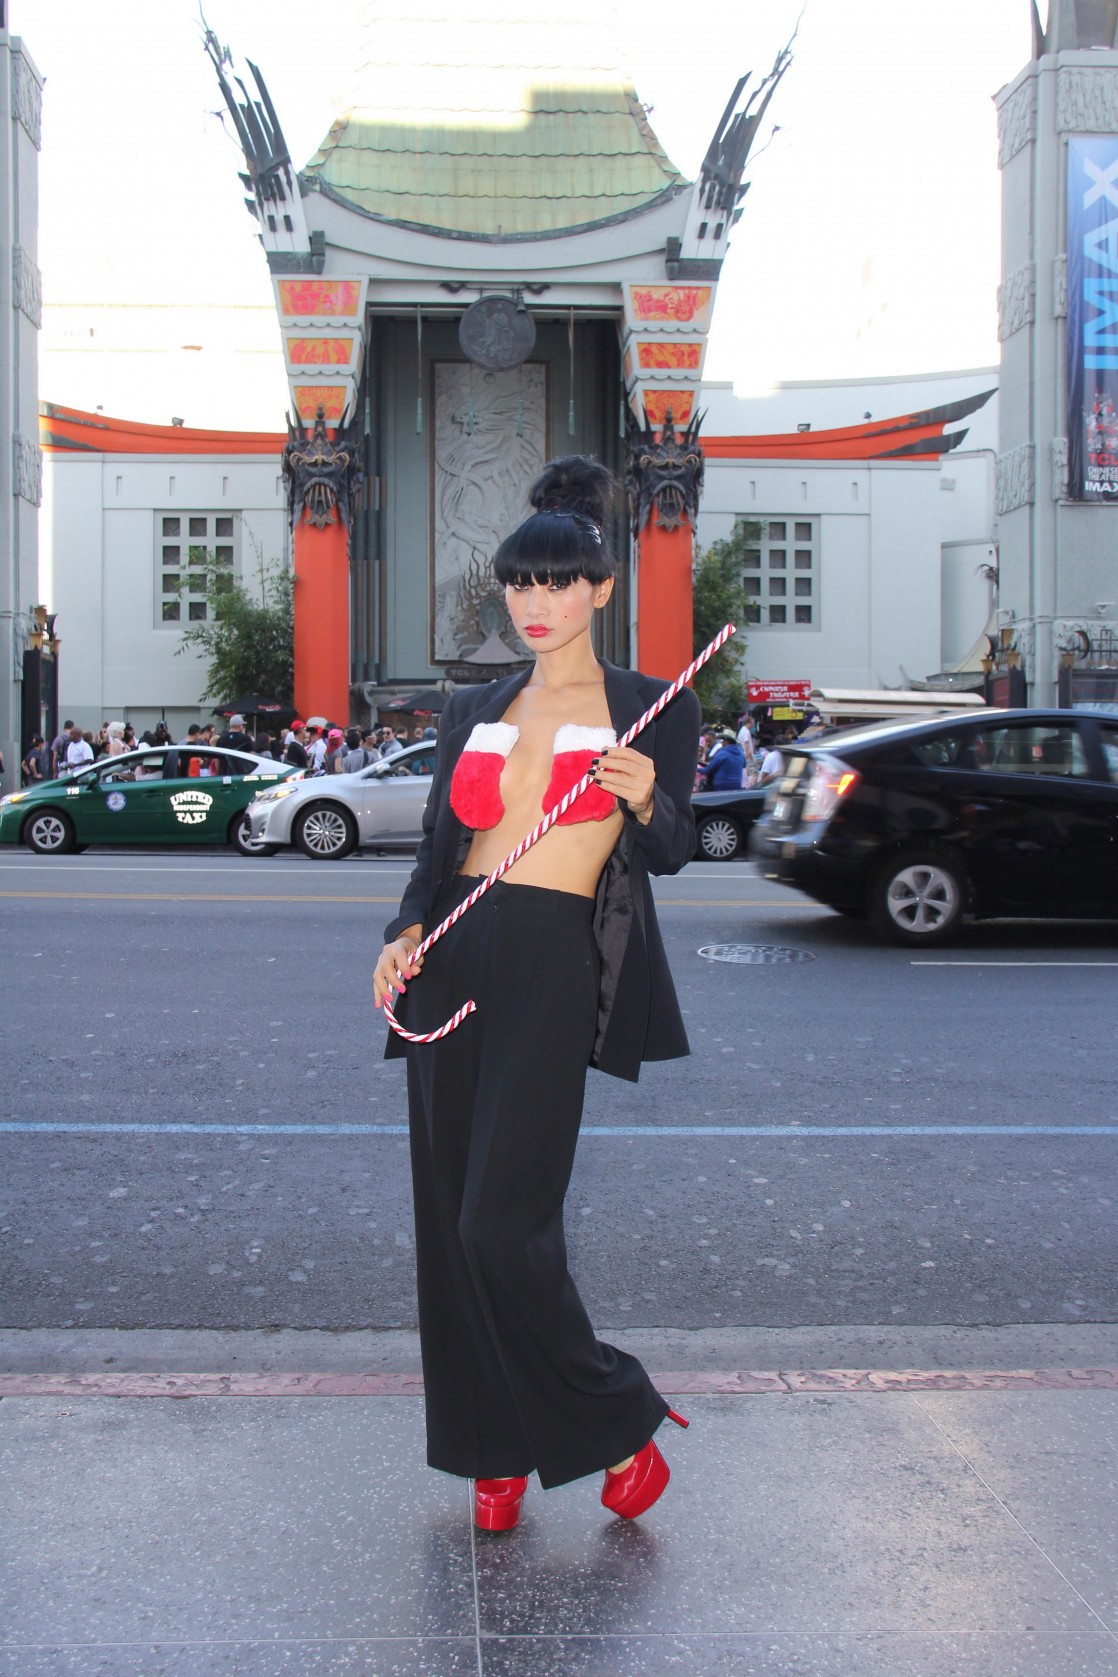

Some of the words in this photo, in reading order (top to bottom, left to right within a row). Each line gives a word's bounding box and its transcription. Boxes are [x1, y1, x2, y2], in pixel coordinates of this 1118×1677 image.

[1083, 154, 1118, 370] IMAX
[1088, 453, 1118, 465] TCL
[1087, 466, 1118, 474] CHINESE
[170, 790, 213, 806] UNITED
[176, 812, 207, 824] TAXI
